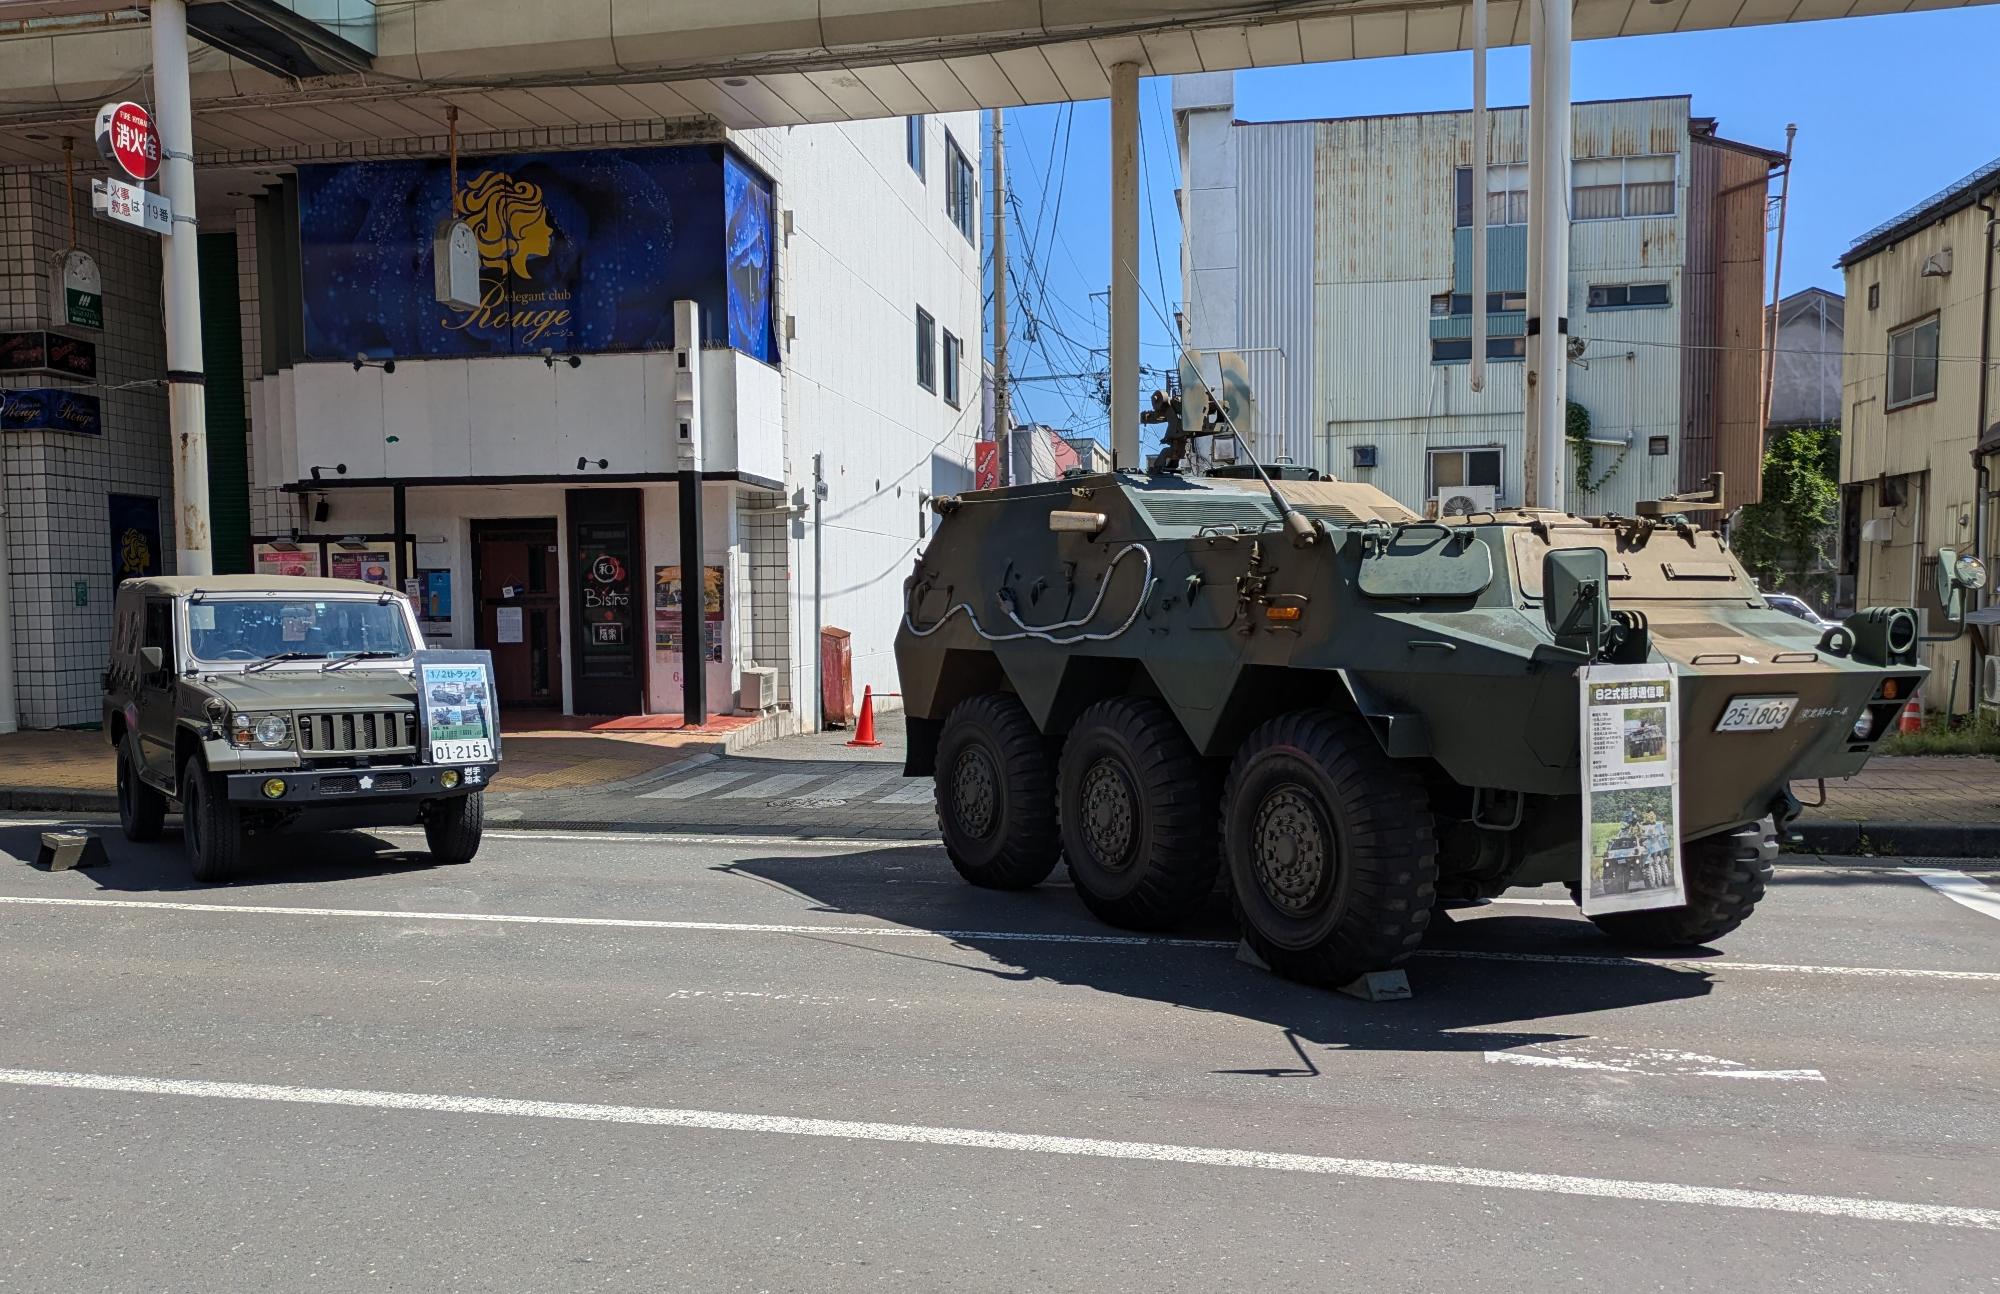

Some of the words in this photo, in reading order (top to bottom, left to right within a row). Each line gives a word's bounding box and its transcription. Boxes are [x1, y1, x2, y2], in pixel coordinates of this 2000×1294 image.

[120, 110, 131, 122] FIRE
[116, 121, 157, 161] 消火栓
[110, 185, 130, 200] 火事
[111, 200, 131, 217] 救急
[504, 290, 544, 304] elegant
[548, 289, 571, 301] club
[441, 278, 571, 344] Rouge
[583, 588, 632, 608] Bistro
[430, 669, 478, 679] 1/2tトラック
[1594, 685, 1665, 701] 82式指揮通信車
[1722, 706, 1790, 726] 25-1803
[435, 744, 489, 760] 01-2151
[464, 767, 480, 776] 岩手
[464, 775, 481, 785] 地本
